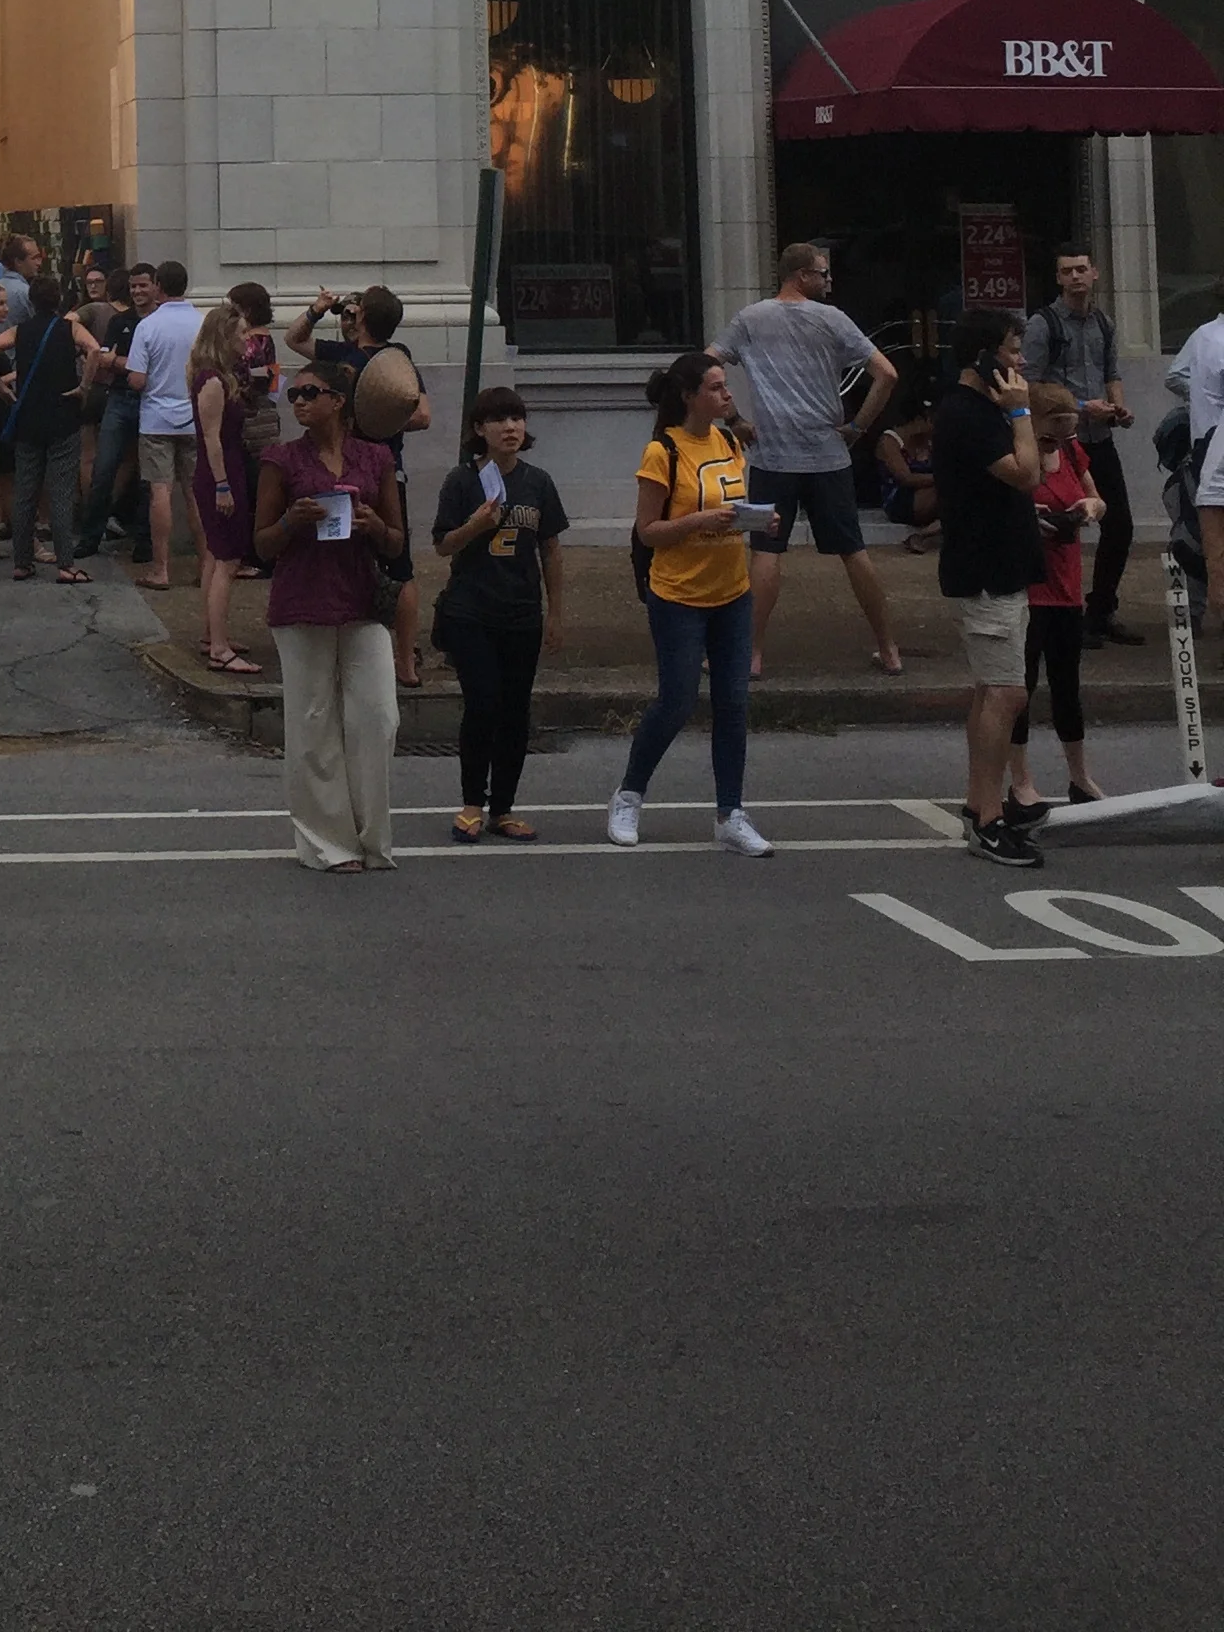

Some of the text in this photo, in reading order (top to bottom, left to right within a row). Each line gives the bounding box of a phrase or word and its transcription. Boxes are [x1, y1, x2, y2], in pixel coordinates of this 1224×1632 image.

[1001, 39, 1114, 78] BB&T
[1168, 564, 1198, 751] WATCH YOUR STEP
